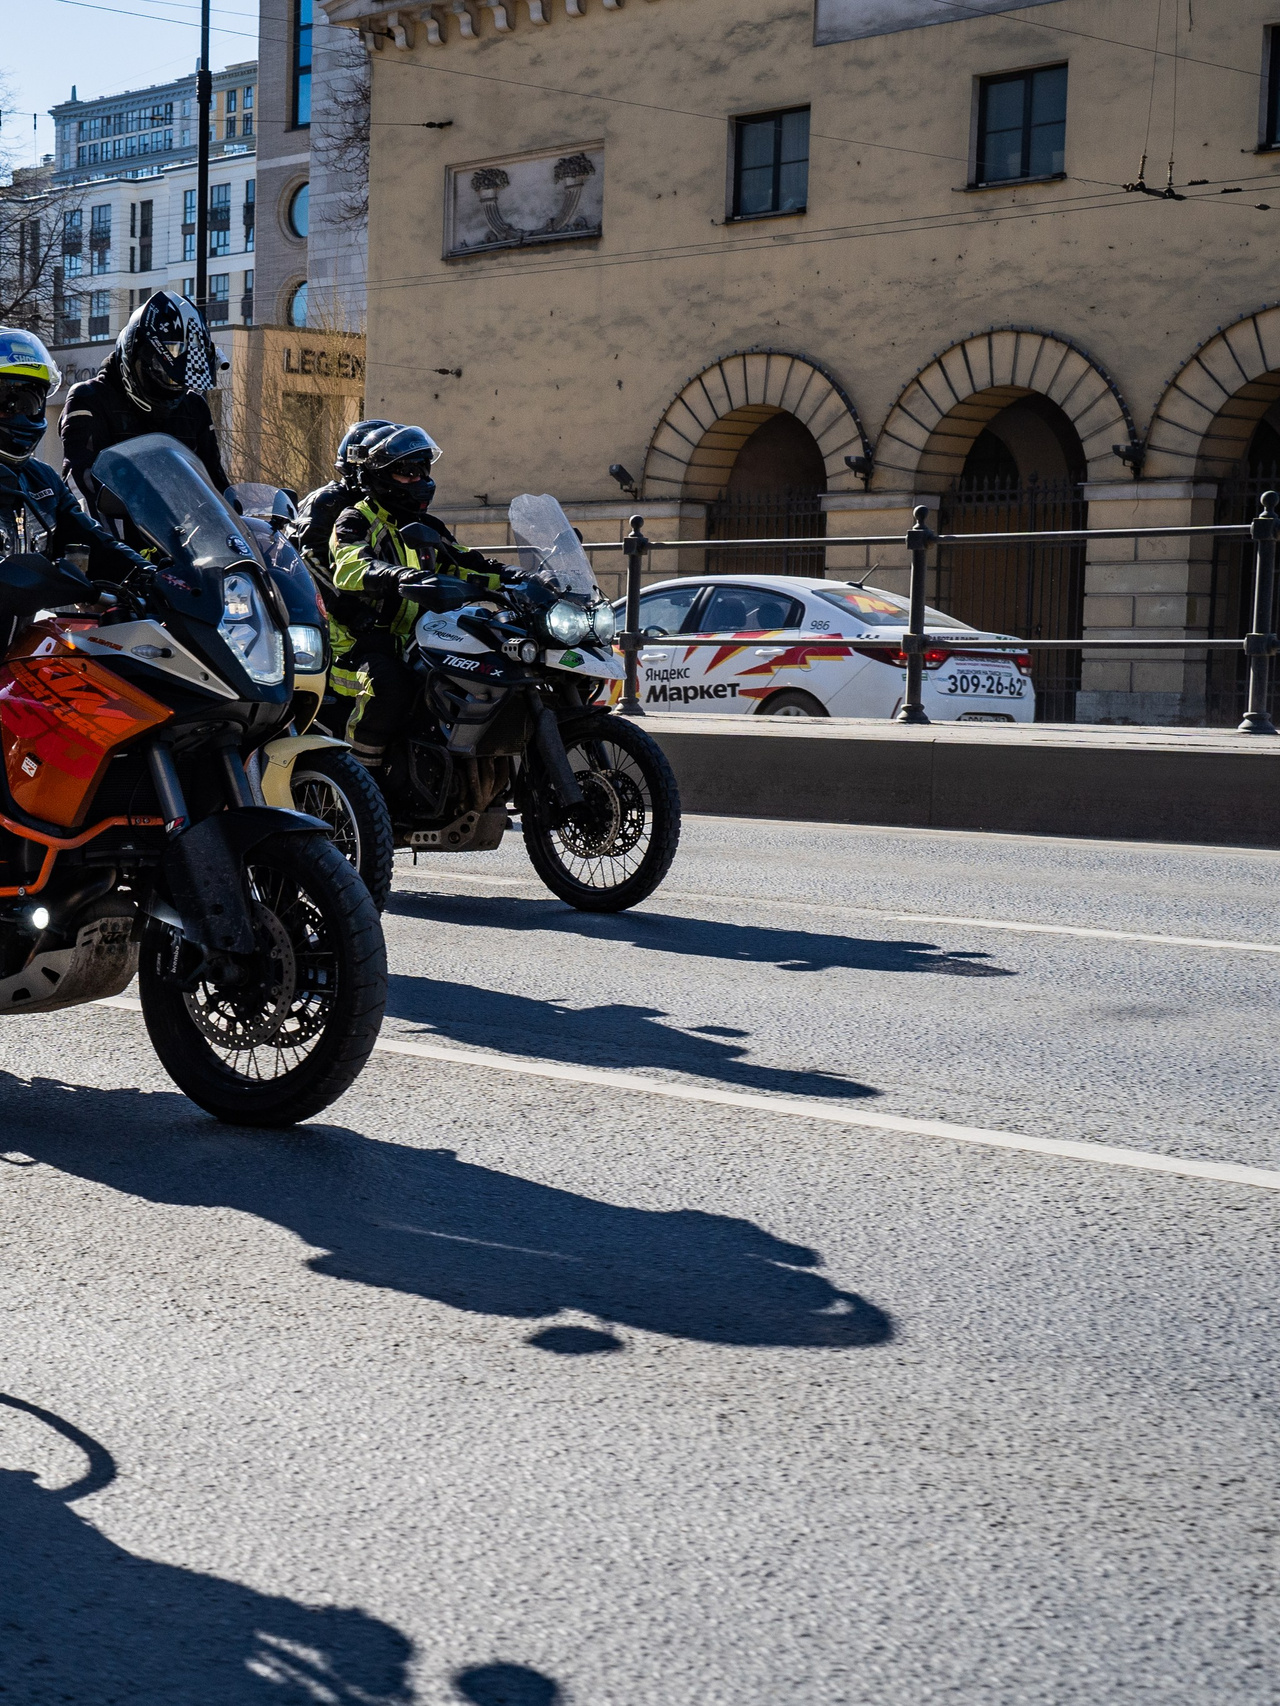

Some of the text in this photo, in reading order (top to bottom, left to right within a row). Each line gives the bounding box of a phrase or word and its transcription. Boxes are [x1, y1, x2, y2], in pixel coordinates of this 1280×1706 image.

[809, 620, 830, 630] 986
[432, 630, 464, 643] TRIUMPH
[442, 655, 480, 671] TIGER
[645, 667, 690, 682] Яндекс
[646, 683, 740, 704] Маркет
[948, 674, 1023, 697] 309-26-62
[171, 945, 180, 974] brembo
